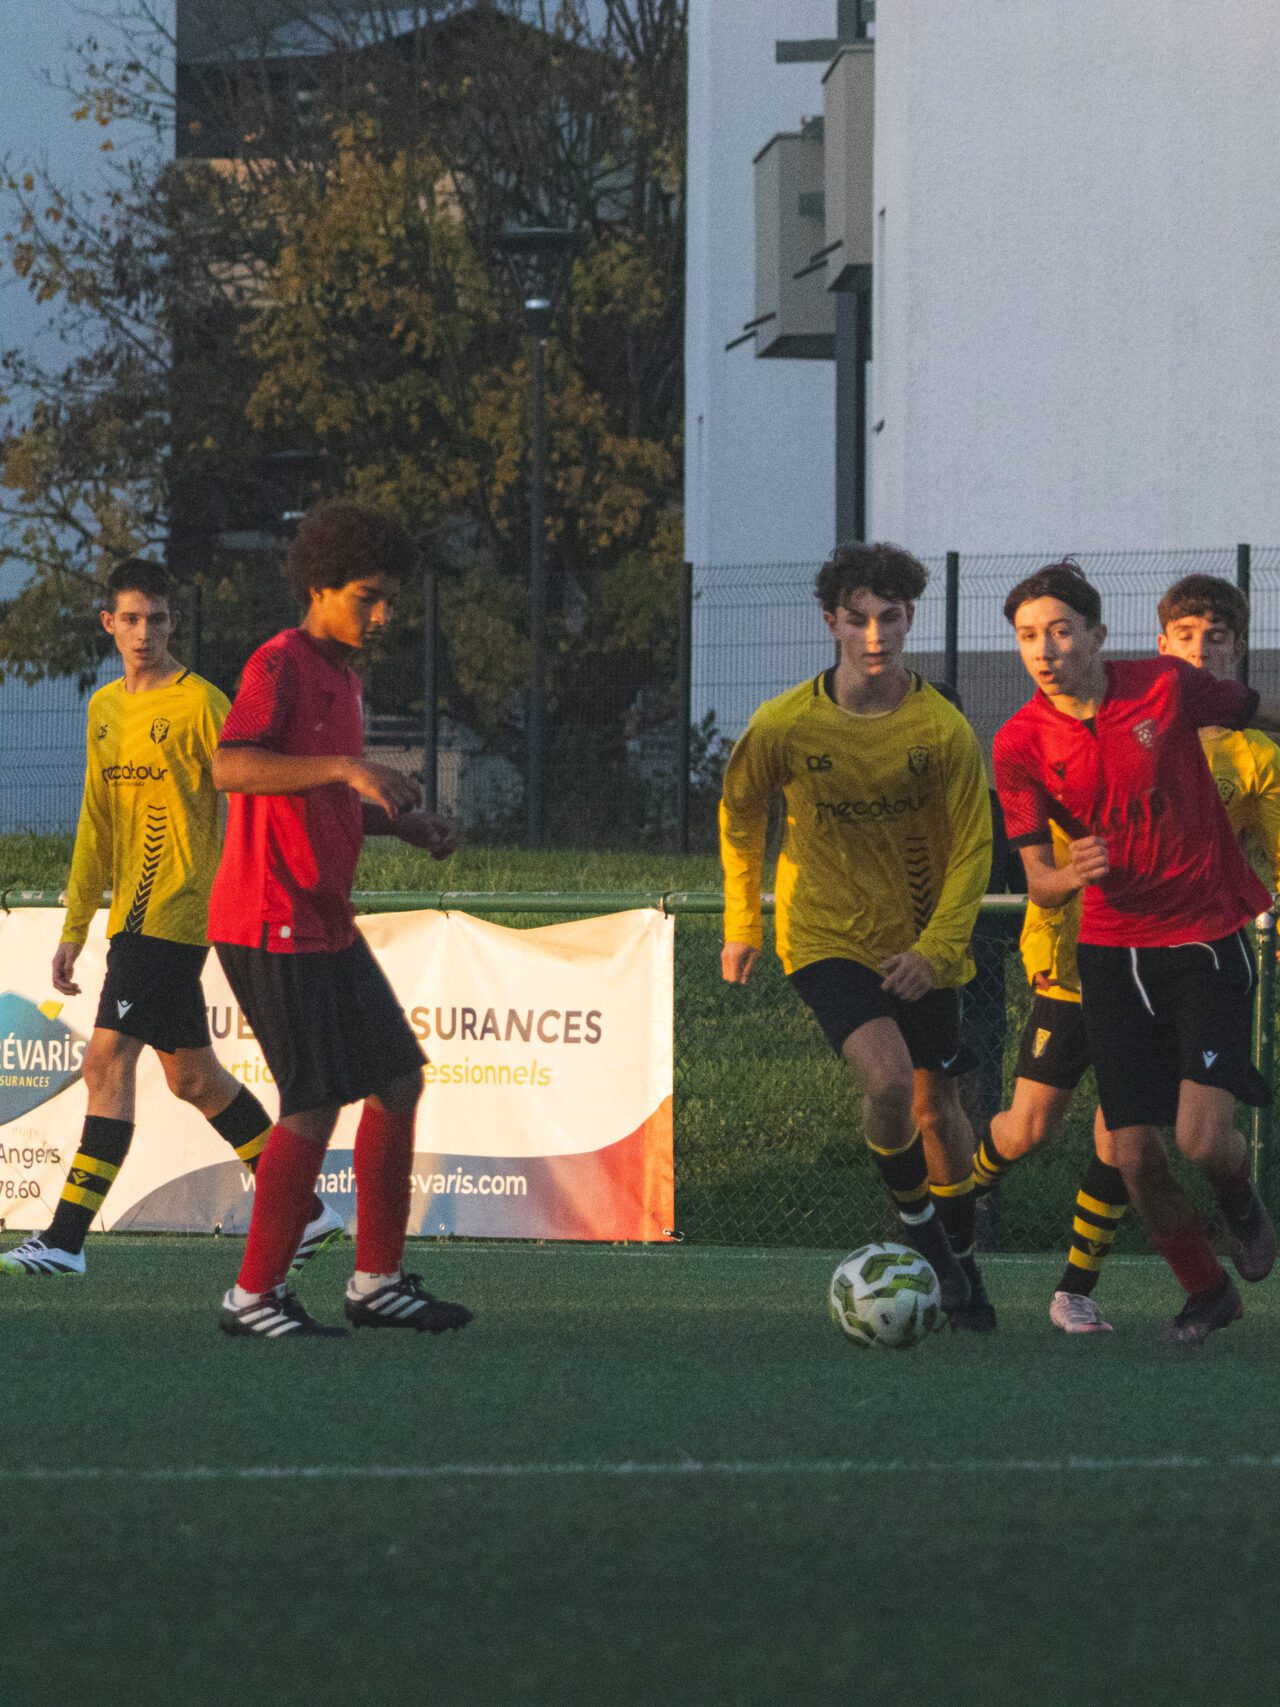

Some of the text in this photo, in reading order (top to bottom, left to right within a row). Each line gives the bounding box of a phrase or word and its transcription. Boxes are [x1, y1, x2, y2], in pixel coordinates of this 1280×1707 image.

[411, 1006, 602, 1044] SURANCES
[0, 1032, 87, 1071] ÉVARiS
[423, 1056, 552, 1086] essionnels
